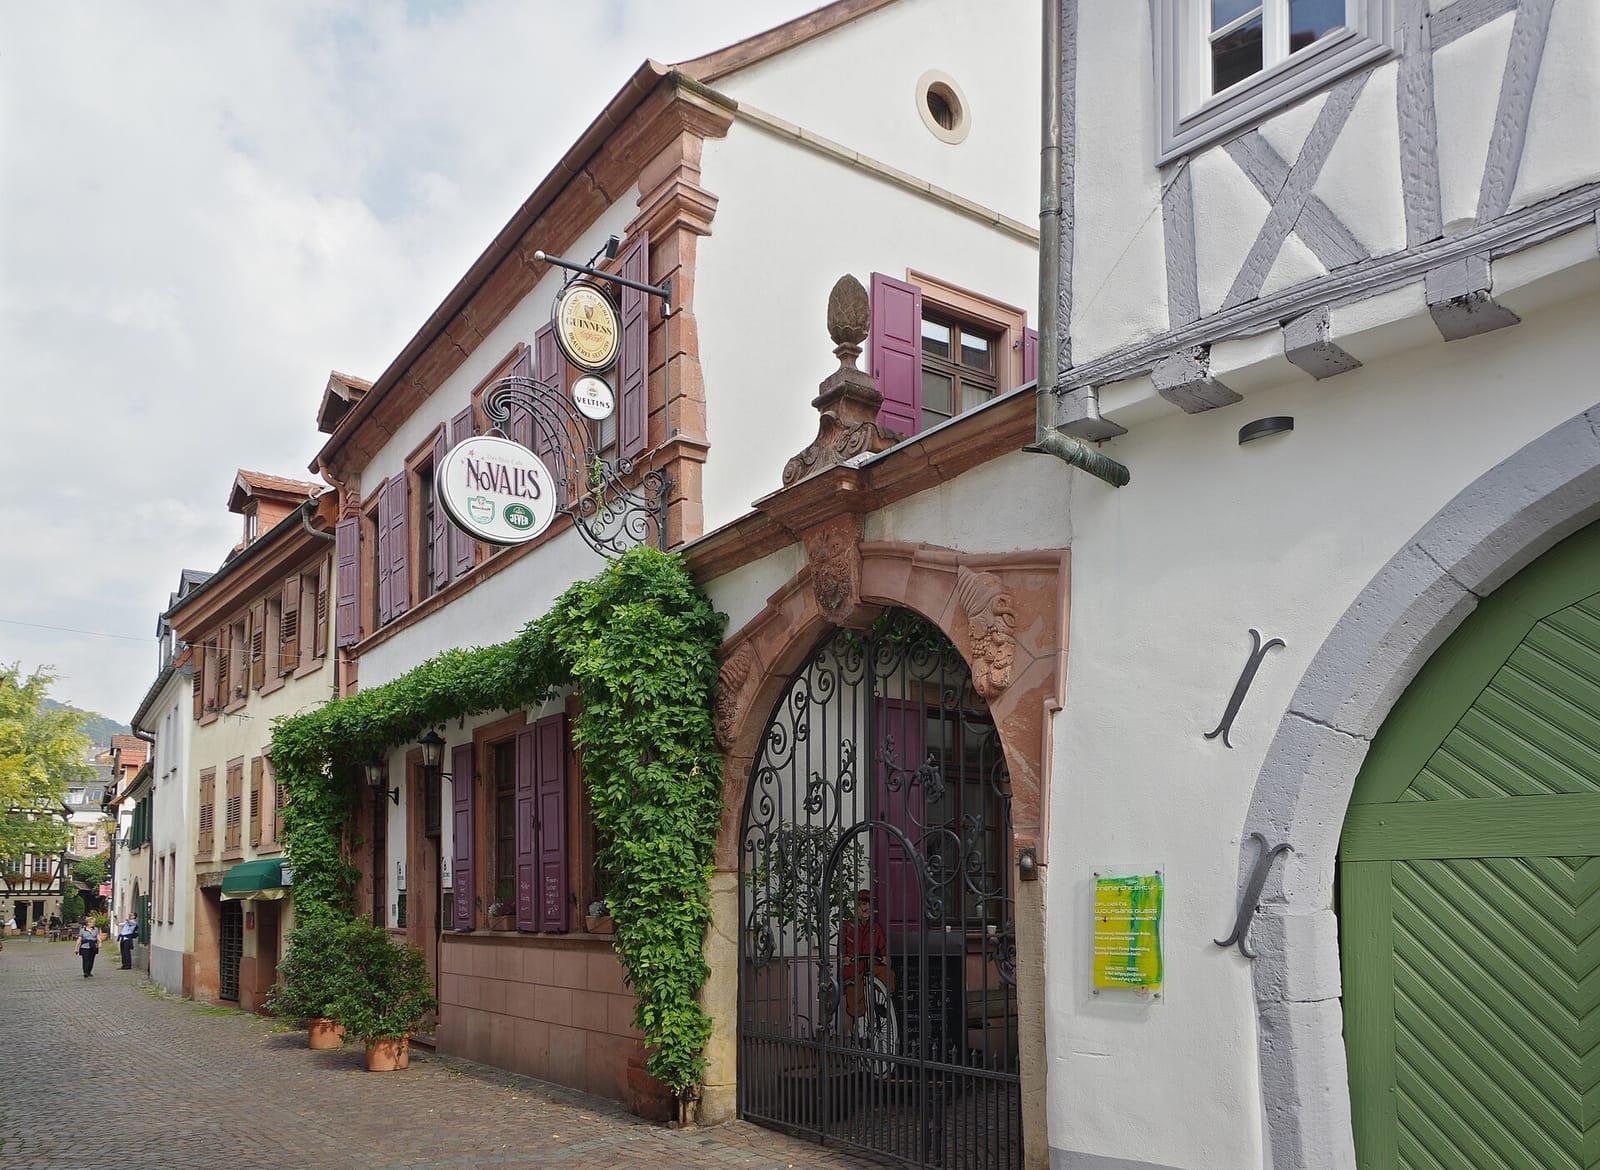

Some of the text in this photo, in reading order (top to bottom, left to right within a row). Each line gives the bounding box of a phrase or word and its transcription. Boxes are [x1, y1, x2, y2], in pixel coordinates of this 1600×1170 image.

[566, 317, 612, 336] GUINNESS
[576, 396, 611, 409] VELTINS
[509, 513, 529, 526] JEVER
